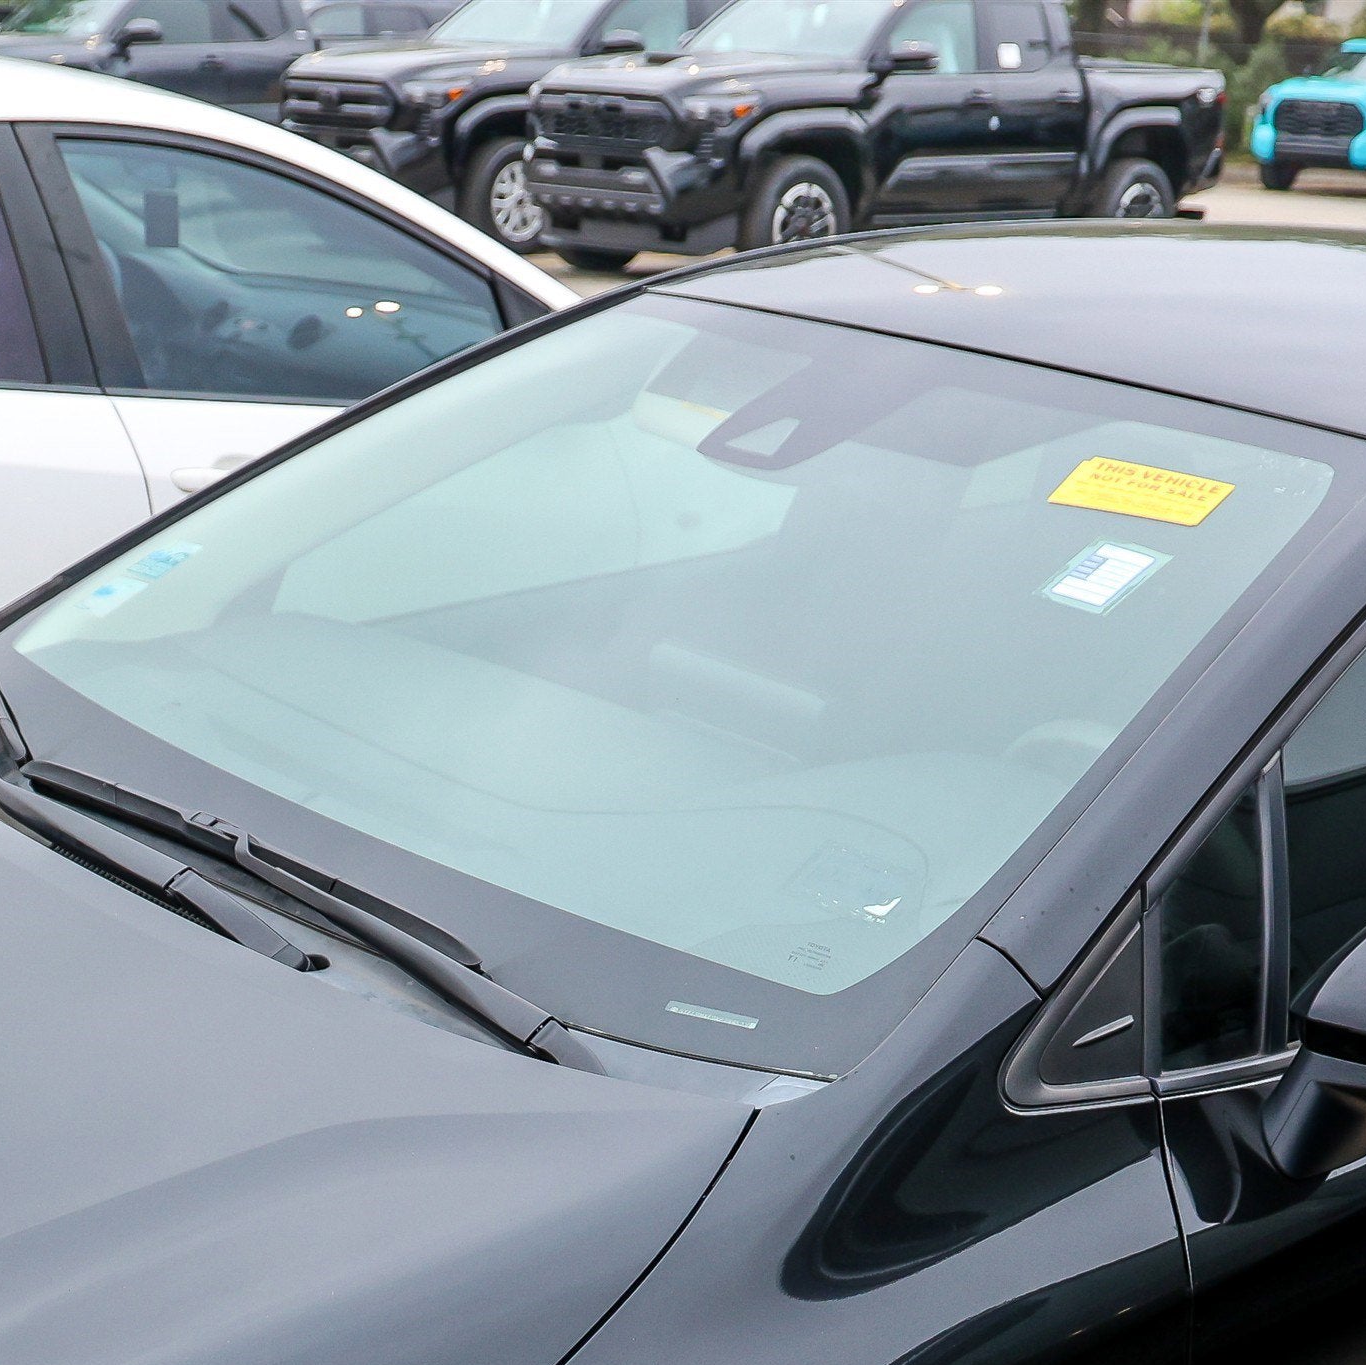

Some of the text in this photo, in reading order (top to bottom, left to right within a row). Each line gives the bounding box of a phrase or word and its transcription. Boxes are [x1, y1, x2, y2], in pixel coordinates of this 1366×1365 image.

[1089, 472, 1209, 502] NOT FOR SALE
[1096, 462, 1223, 494] THIS VEHICLE
[807, 941, 832, 953] TOYOTA
